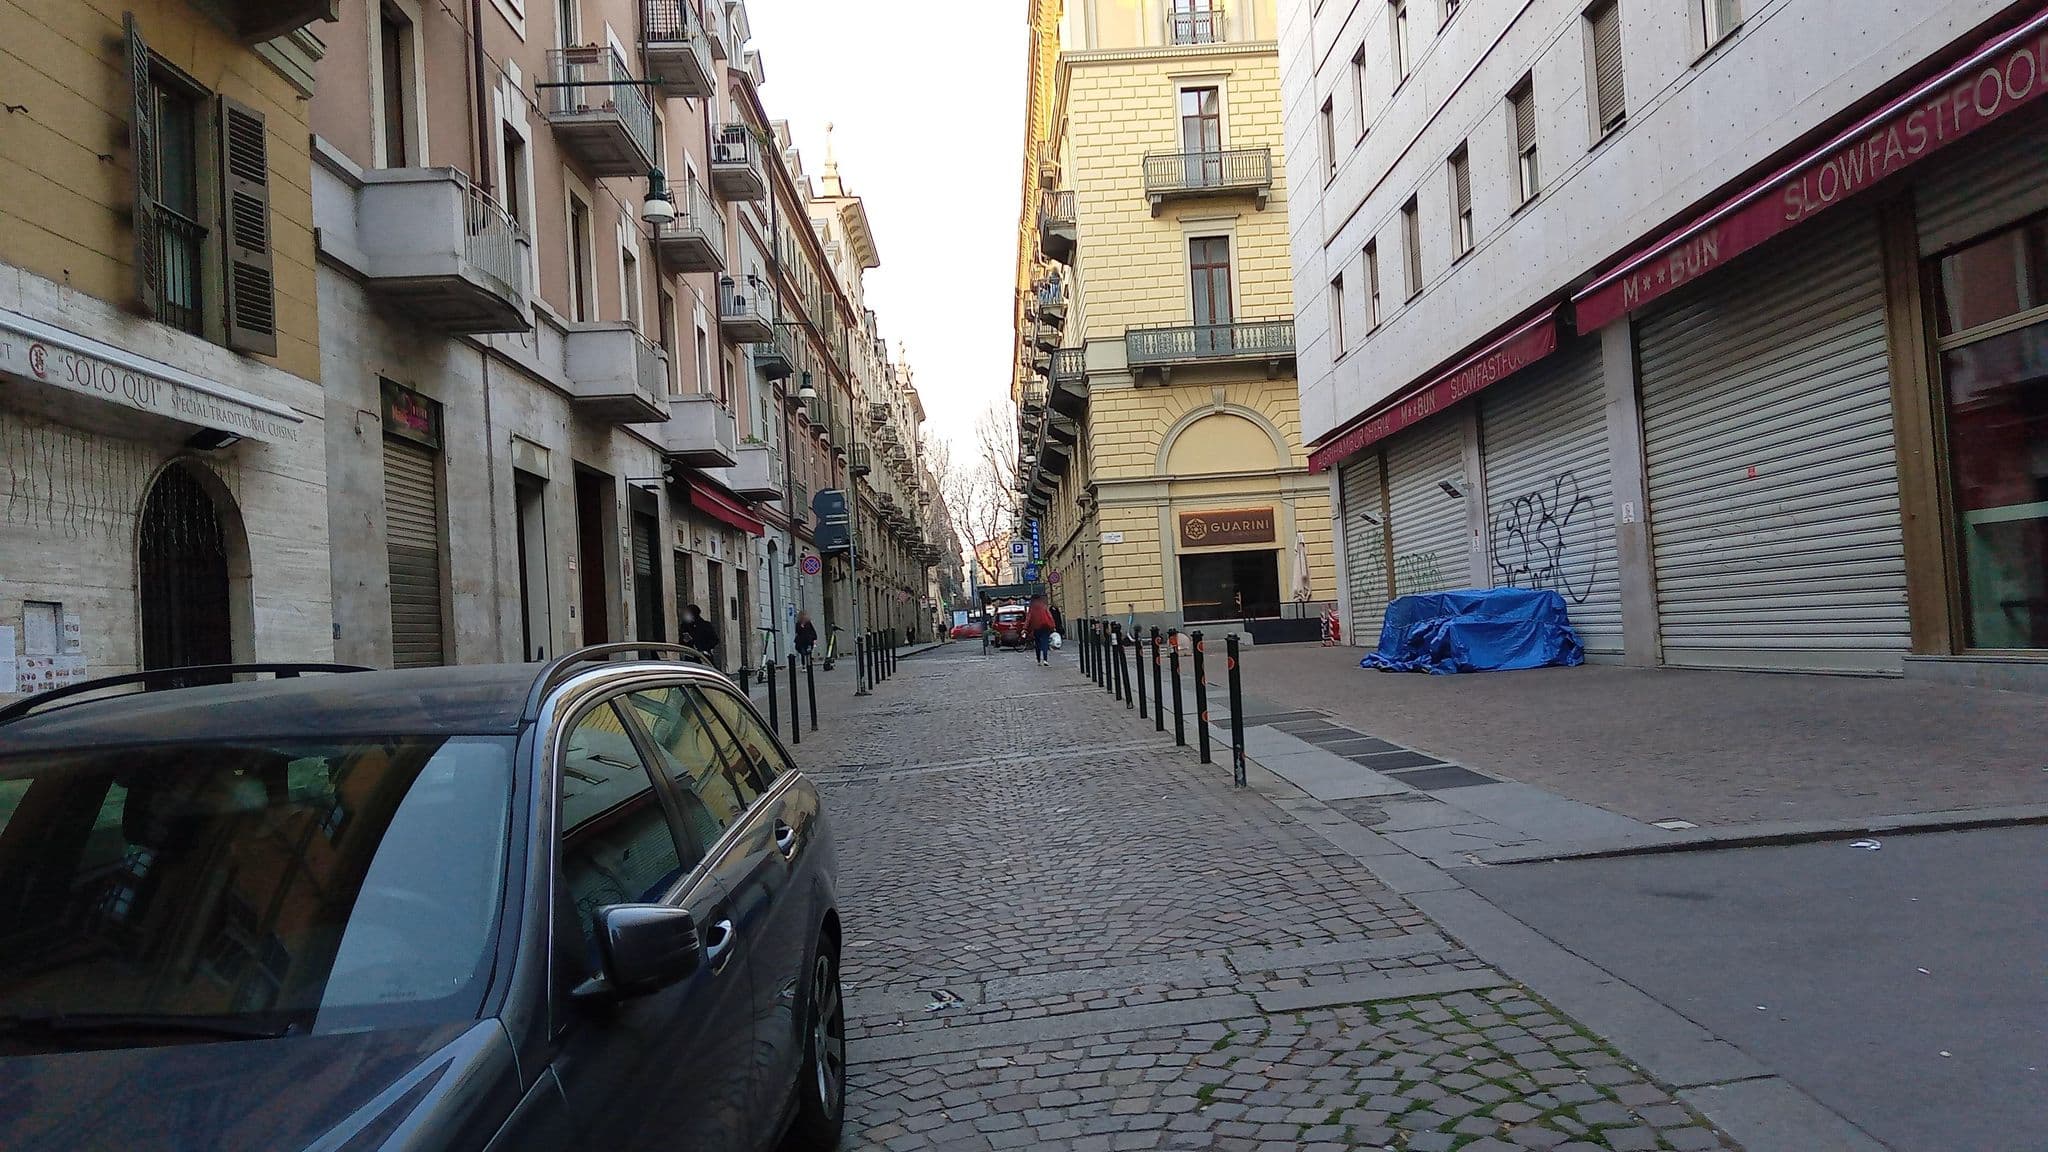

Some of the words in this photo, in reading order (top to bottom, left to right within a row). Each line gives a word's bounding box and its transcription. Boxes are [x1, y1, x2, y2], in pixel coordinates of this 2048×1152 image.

[1784, 35, 2048, 221] SLOWFASTFOO
[171, 395, 208, 419] SPECIAL
[209, 405, 267, 434] TRADITIONAL
[268, 422, 298, 442] CUISINE
[1210, 519, 1269, 532] GUARINI
